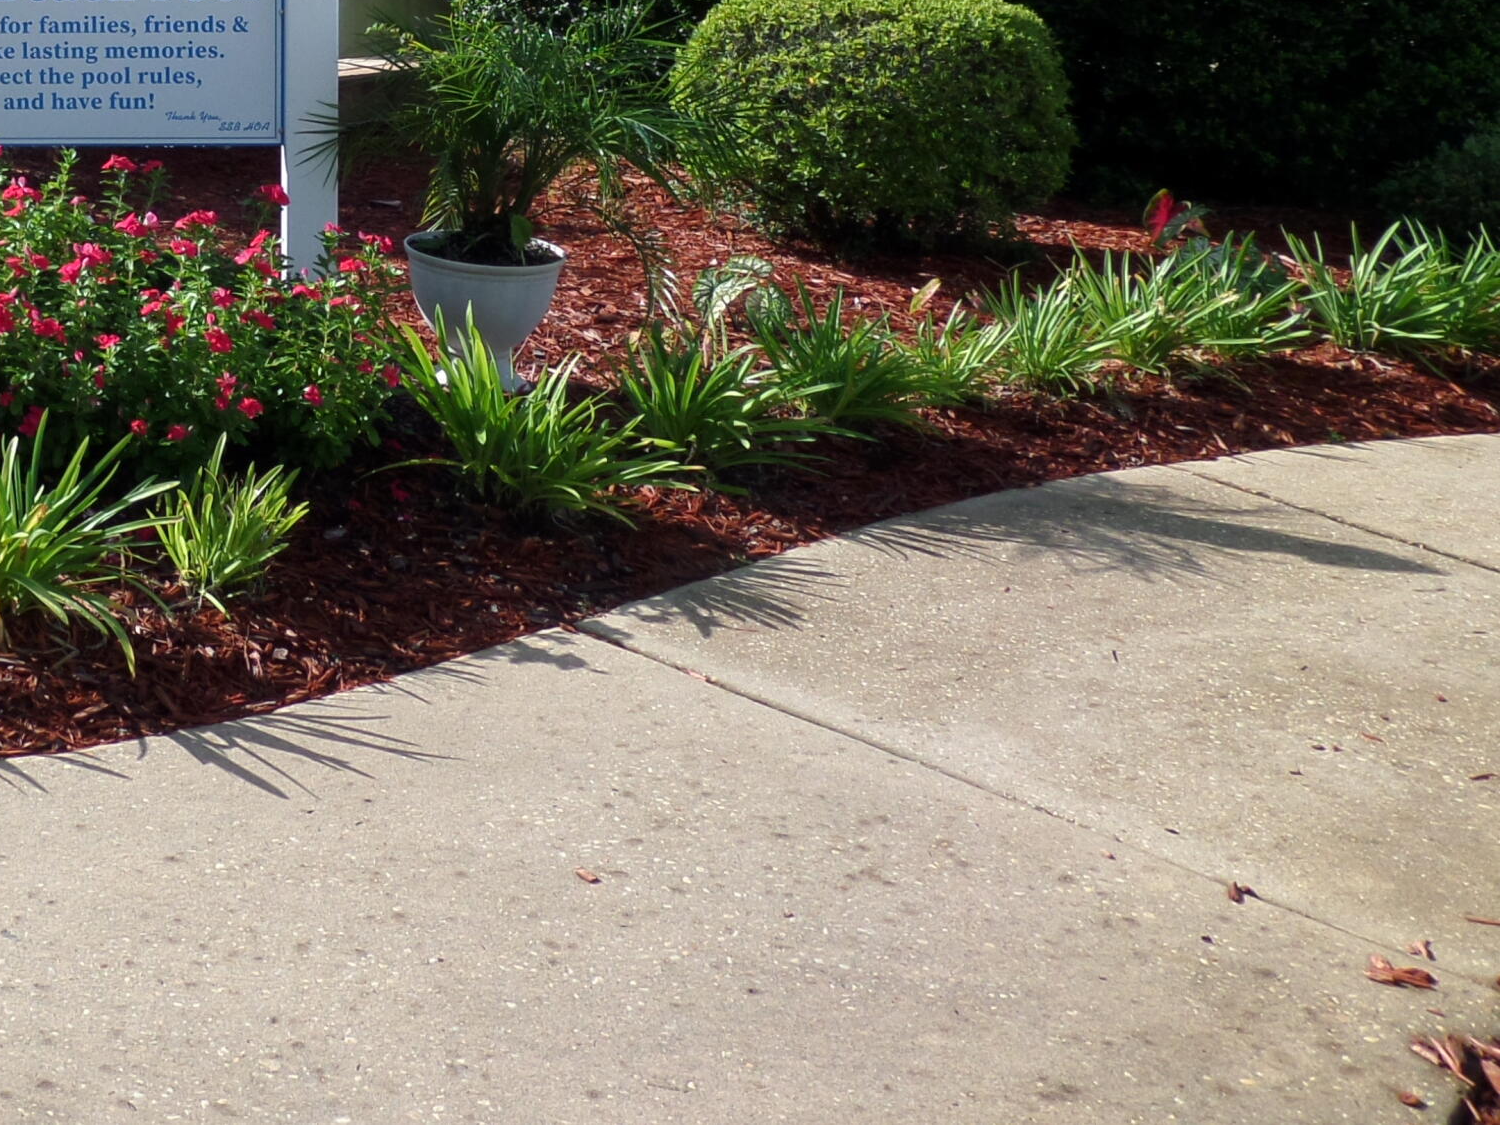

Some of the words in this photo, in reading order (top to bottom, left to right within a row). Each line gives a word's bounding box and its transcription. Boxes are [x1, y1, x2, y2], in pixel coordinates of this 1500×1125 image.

[0, 15, 33, 35] for
[39, 15, 137, 38] families,
[143, 14, 226, 34] friends
[231, 15, 249, 33] &
[21, 40, 99, 65] lasting
[104, 39, 225, 60] memories.
[38, 66, 75, 85] the
[81, 66, 132, 90] pool
[137, 66, 203, 89] rules,
[3, 91, 45, 111] and
[51, 91, 103, 111] have
[108, 90, 155, 111] fun!
[165, 111, 196, 121] Thank
